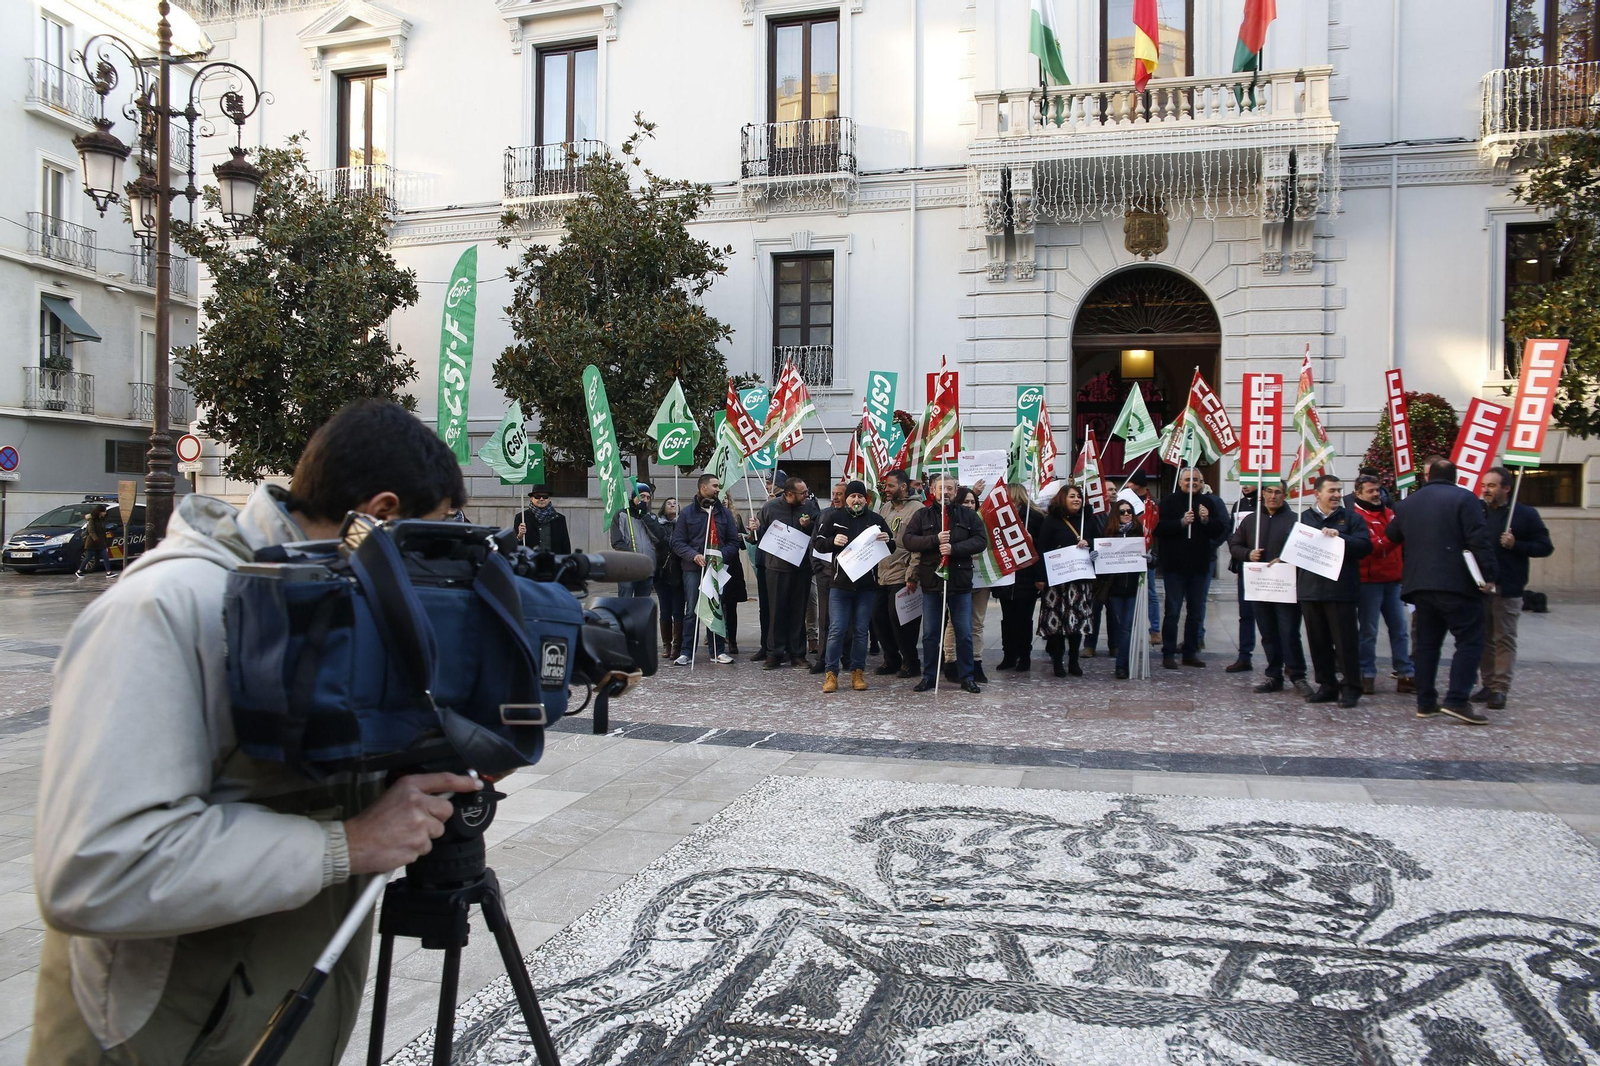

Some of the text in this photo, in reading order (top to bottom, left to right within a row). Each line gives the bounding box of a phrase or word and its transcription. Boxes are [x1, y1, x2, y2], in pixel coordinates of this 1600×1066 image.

[1192, 377, 1236, 447] CCOO
[1204, 413, 1227, 450] Granada
[1248, 376, 1275, 470] CCOO
[1388, 372, 1411, 473] CCOO
[1513, 342, 1560, 449] CCOO
[1457, 402, 1503, 492] CCOO
[990, 485, 1033, 566] CCOO
[992, 526, 1013, 570] Granada
[543, 664, 564, 677] brace
[545, 653, 565, 666] porta
